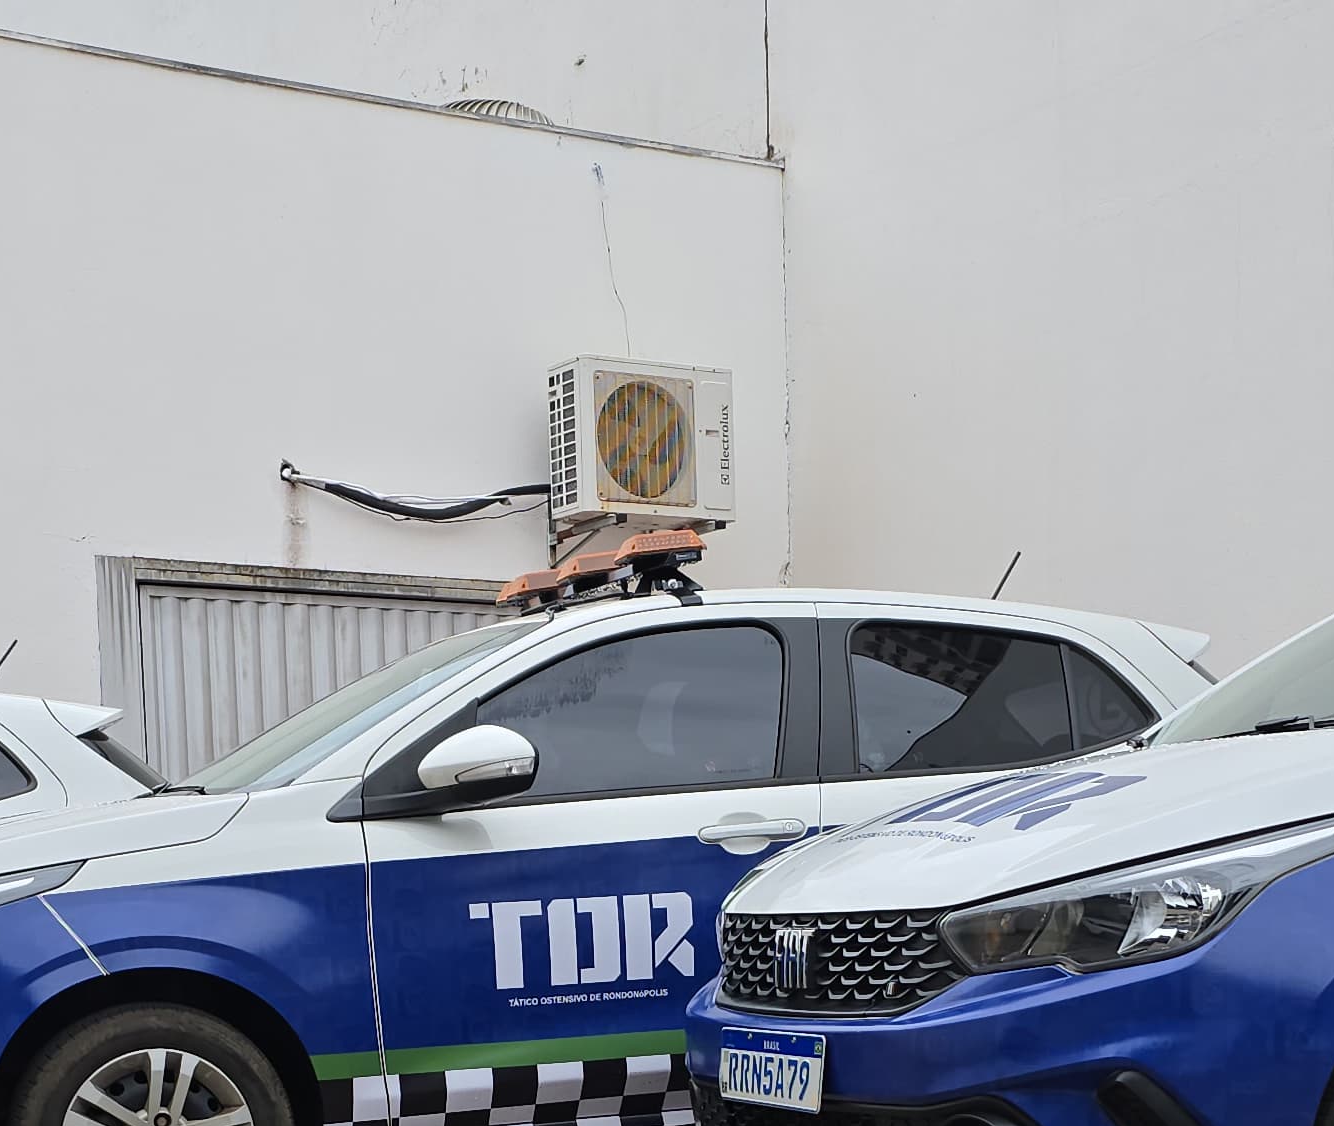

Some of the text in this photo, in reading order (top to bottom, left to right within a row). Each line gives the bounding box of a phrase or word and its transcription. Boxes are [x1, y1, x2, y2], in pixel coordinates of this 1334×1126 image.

[720, 404, 730, 470] Electrolux
[468, 891, 695, 990] TOR
[774, 927, 817, 989] FIAT
[508, 996, 538, 1008] TÁTICO
[540, 993, 588, 1005] OSTENSIVO
[589, 993, 601, 1002] DE
[763, 1039, 780, 1051] BRASIL
[728, 1053, 811, 1101] RRN5A79
